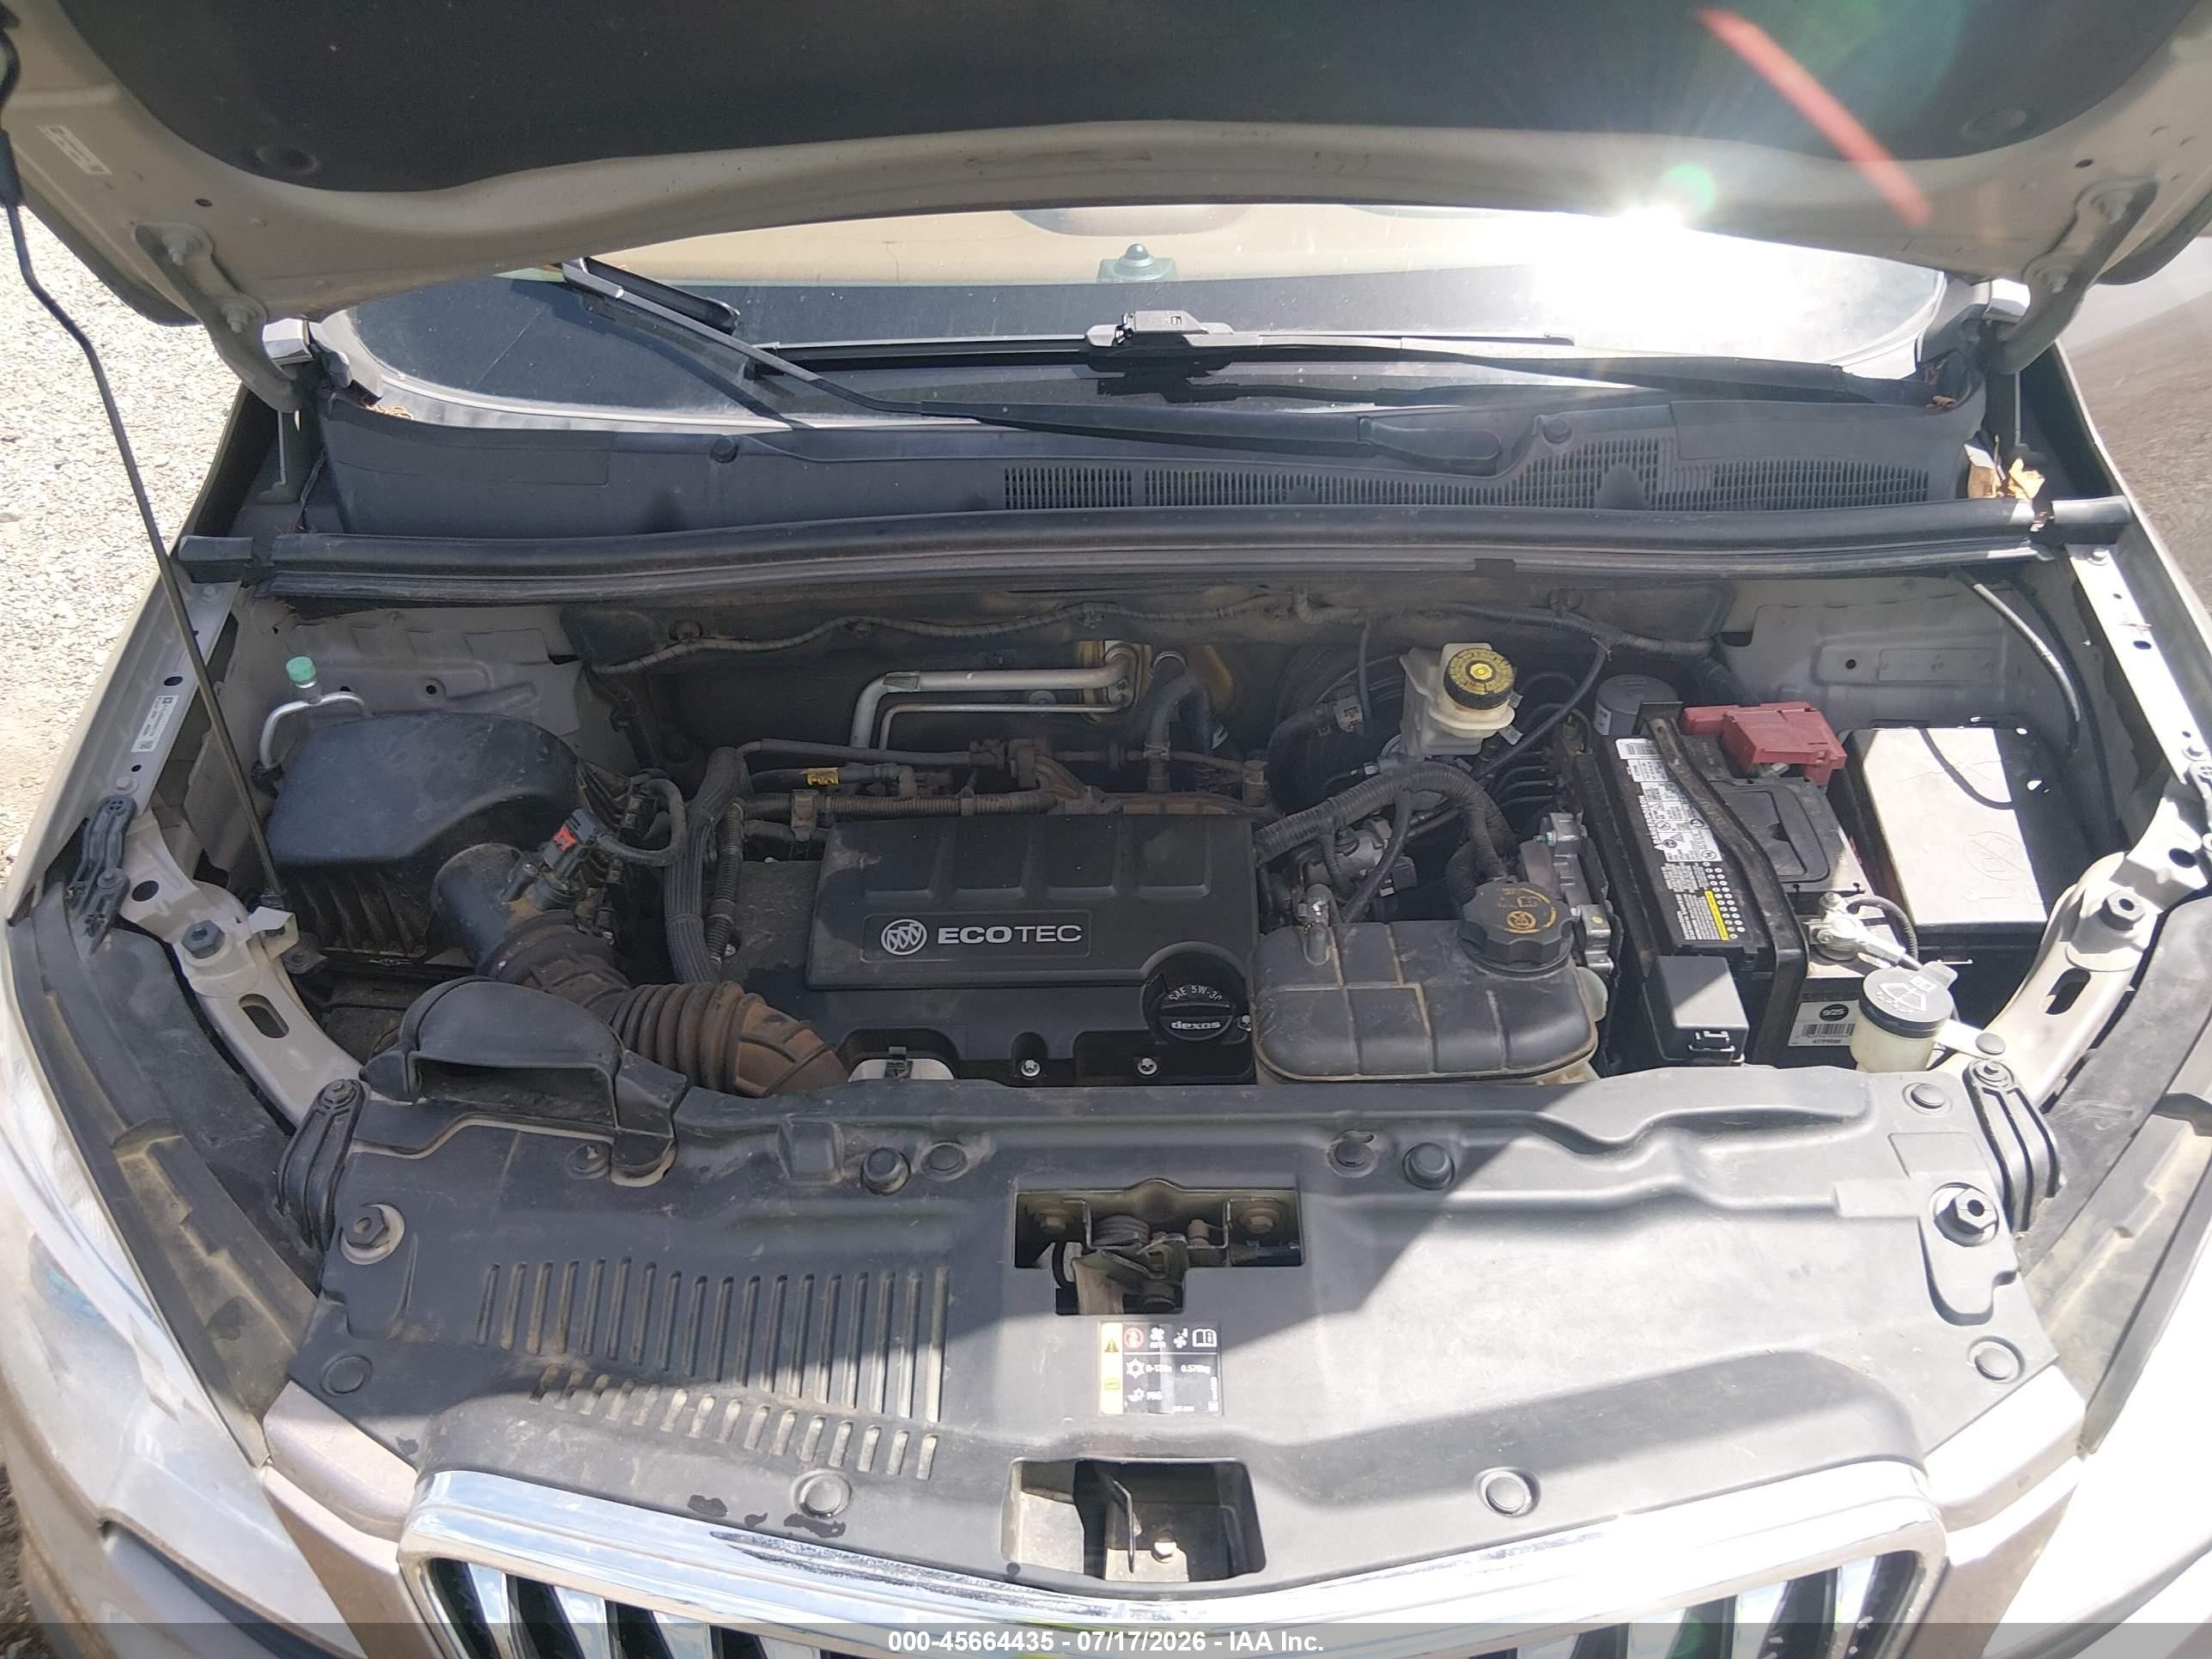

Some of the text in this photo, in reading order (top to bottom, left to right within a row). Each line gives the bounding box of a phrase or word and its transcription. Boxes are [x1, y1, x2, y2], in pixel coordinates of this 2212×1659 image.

[937, 924, 1083, 945] ECOTEC
[1168, 987, 1188, 1001] SAE
[1171, 1021, 1221, 1030] dexos
